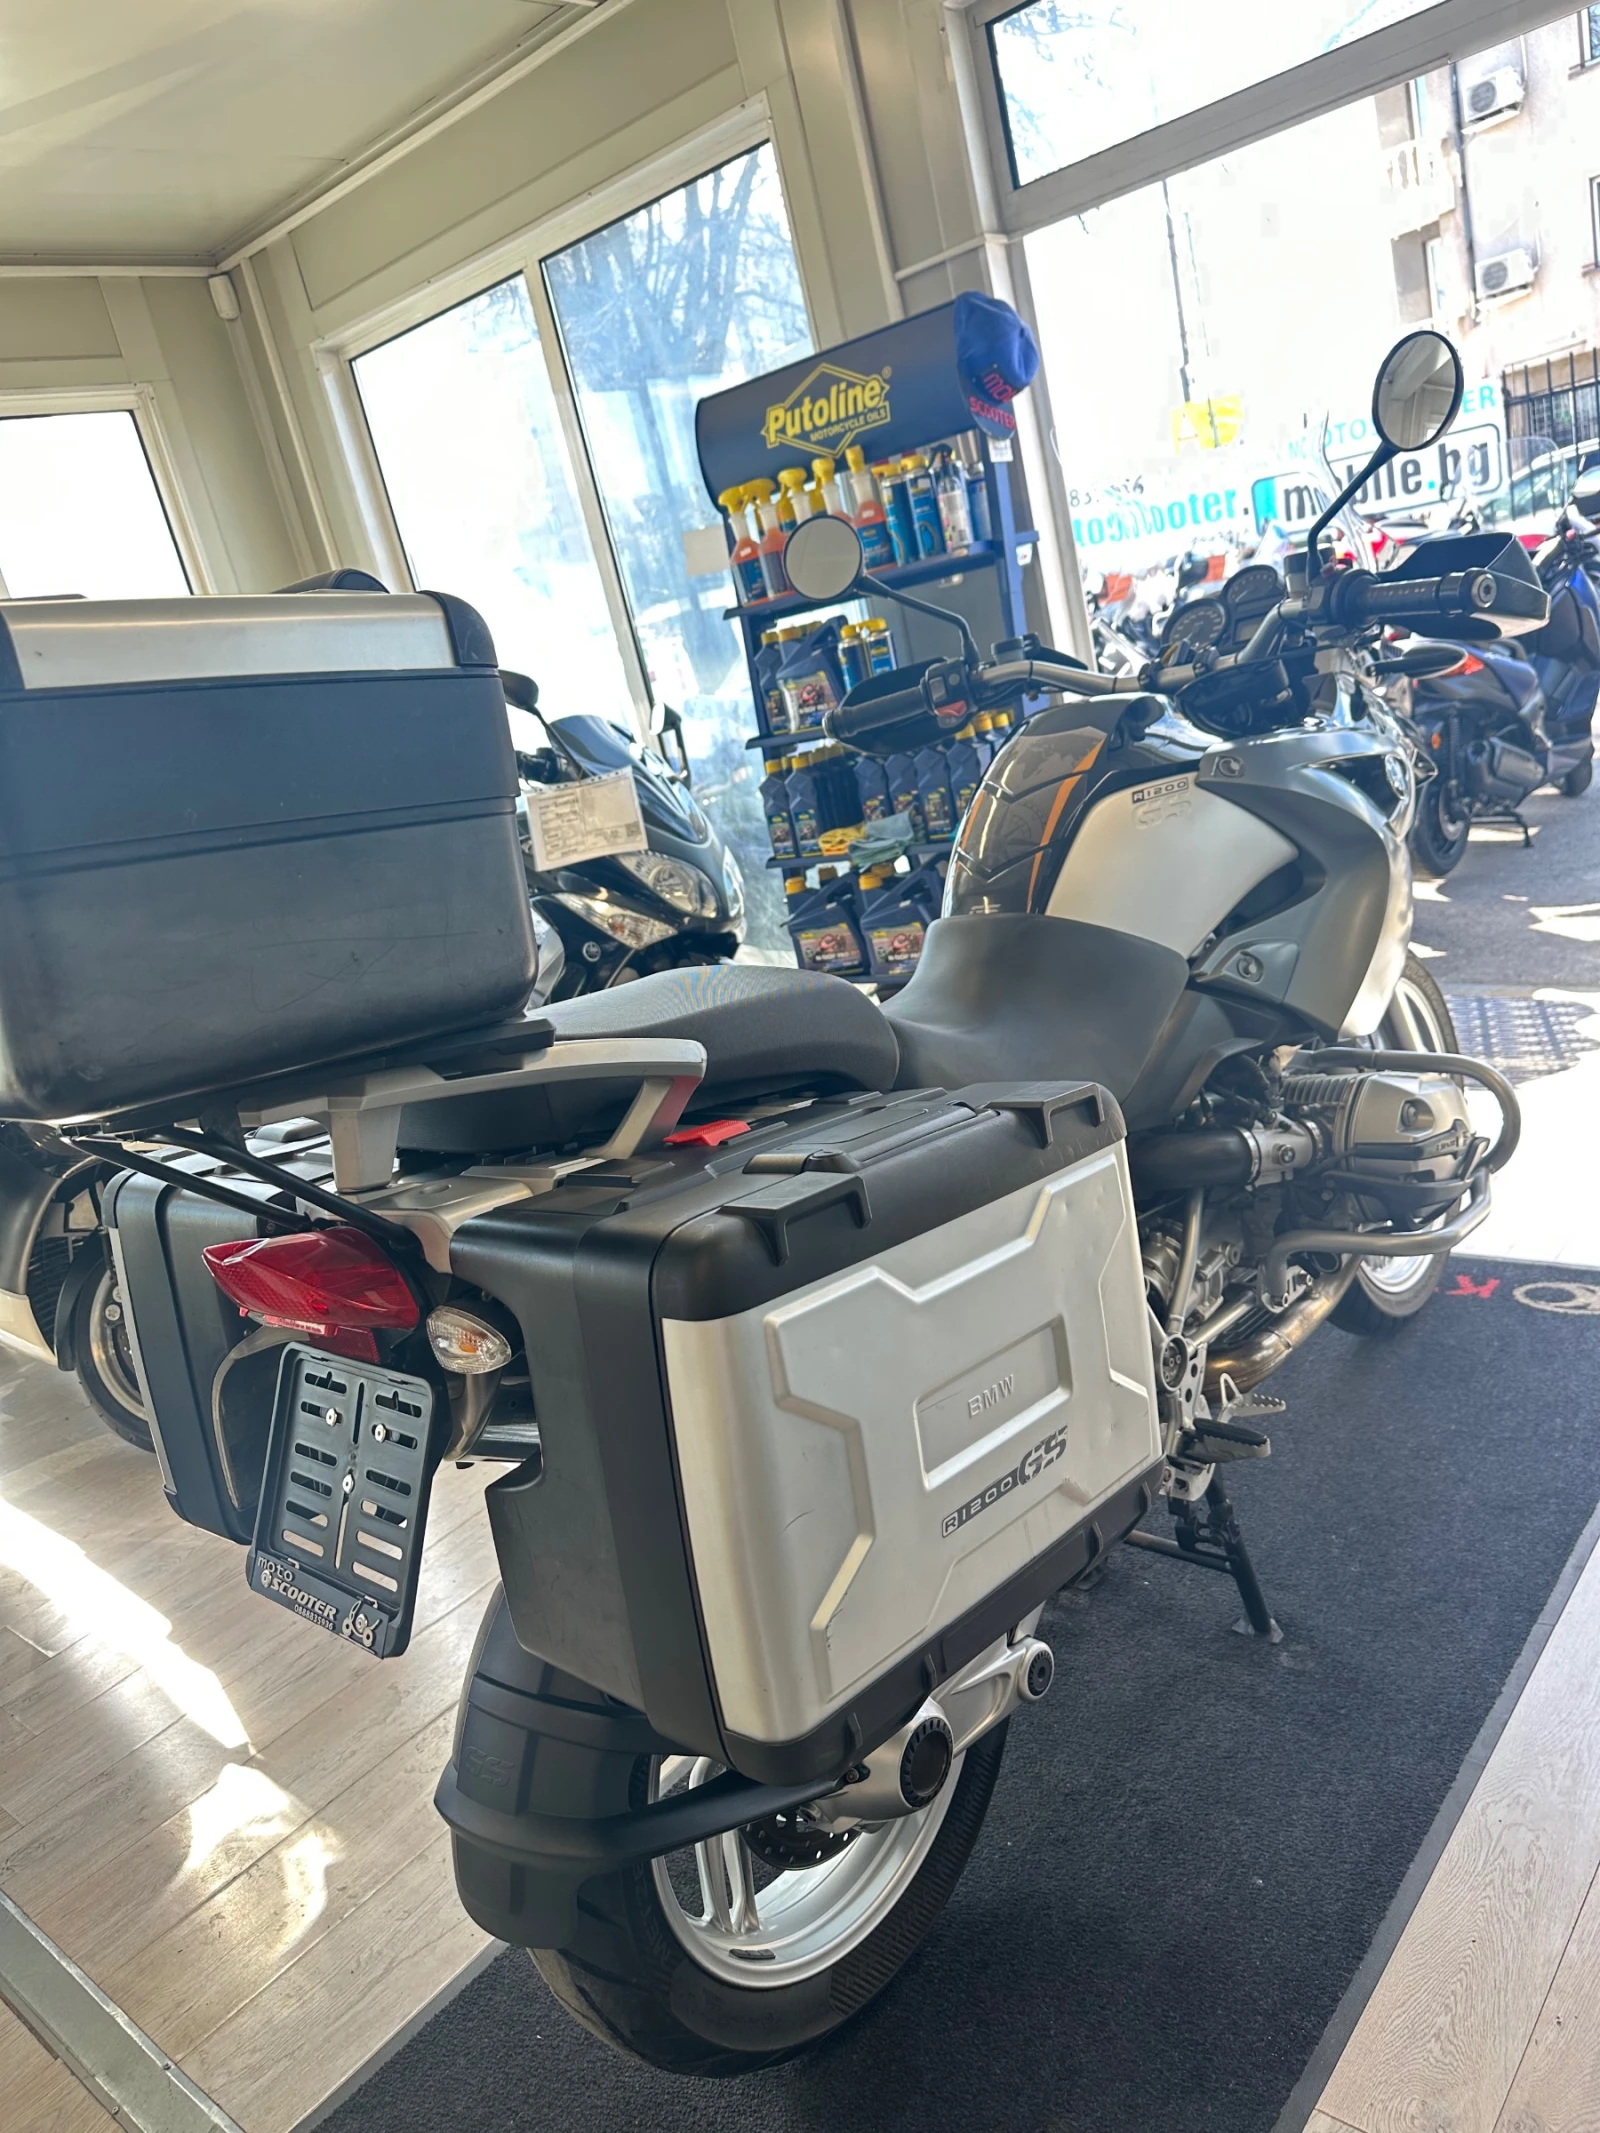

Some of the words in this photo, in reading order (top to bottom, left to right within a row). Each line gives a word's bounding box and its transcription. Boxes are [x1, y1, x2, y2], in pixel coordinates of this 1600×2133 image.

[769, 380, 881, 443] Putoline
[810, 416, 865, 442] MOTORCYCLE
[866, 408, 887, 421] OILS
[1133, 779, 1187, 802] R1200
[968, 1374, 1014, 1419] BMW
[258, 1557, 293, 1582] moto
[270, 1578, 338, 1621] SCOOTER
